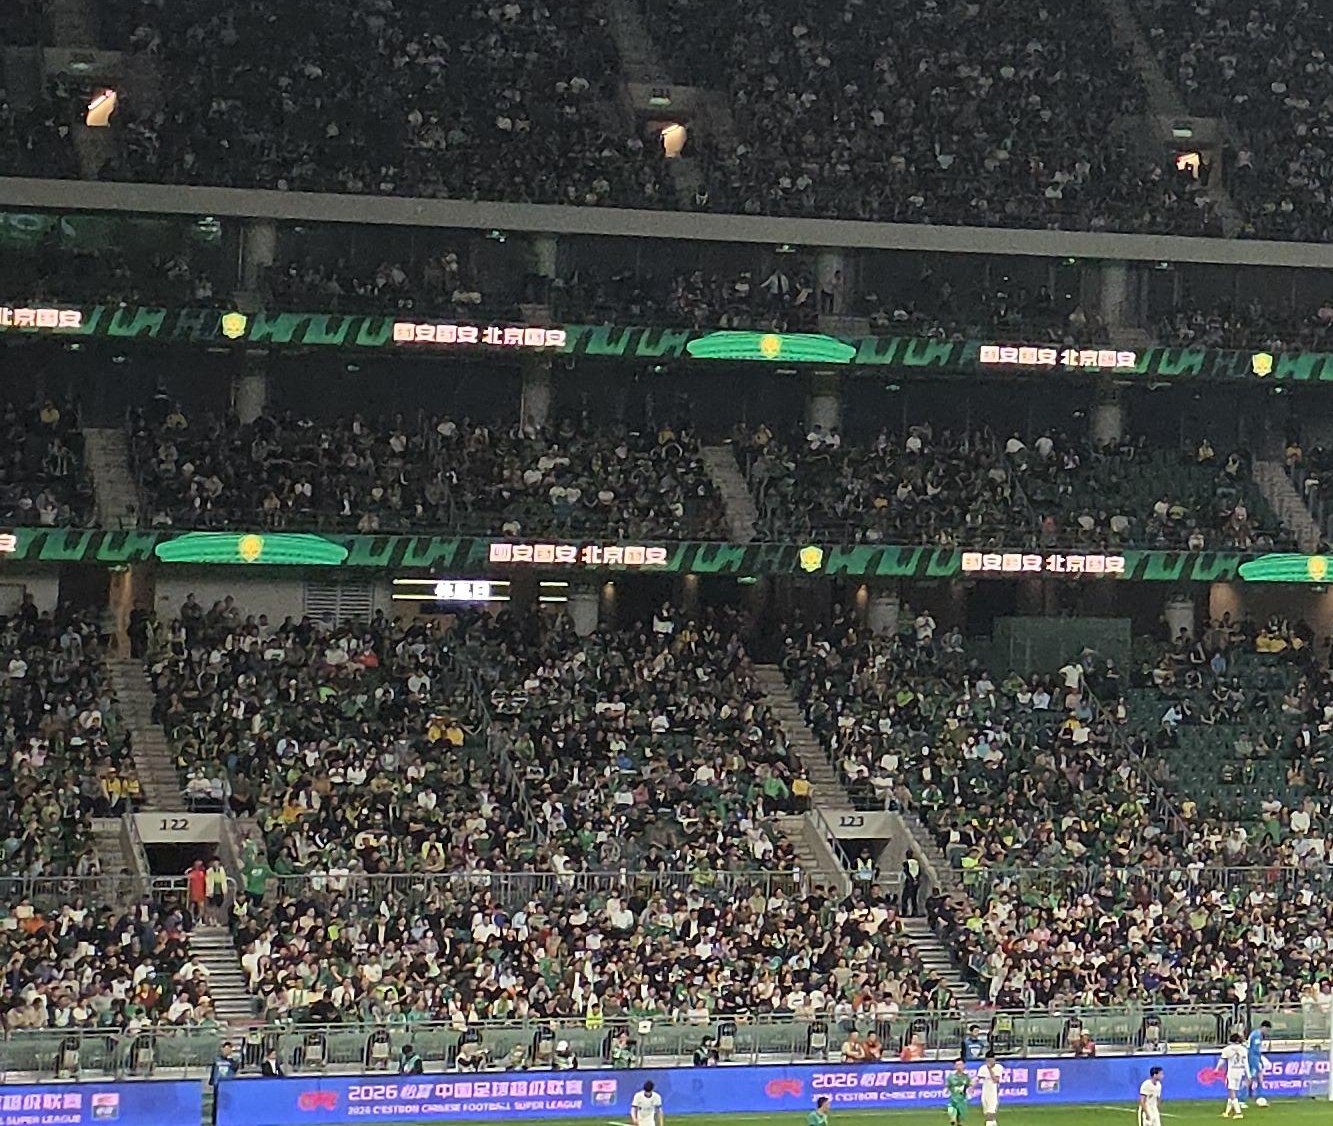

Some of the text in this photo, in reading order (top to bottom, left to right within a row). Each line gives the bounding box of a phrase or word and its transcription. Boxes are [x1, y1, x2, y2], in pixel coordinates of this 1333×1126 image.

[394, 323, 565, 346] 国安国安 北京国安
[980, 346, 1136, 367] 国安国安 北京国安
[490, 544, 666, 564] 国安国安 北京国安
[962, 553, 1124, 572] 国安国安 北京国安
[160, 819, 190, 831] 122
[839, 816, 864, 827] 123
[812, 1072, 858, 1088] 2026
[348, 1084, 399, 1101] 2026
[435, 1078, 583, 1099] 中国足球超级联赛
[514, 1100, 544, 1111] SUPER
[546, 1099, 583, 1110] LEAGUE
[41, 1114, 81, 1124] LEAGUE
